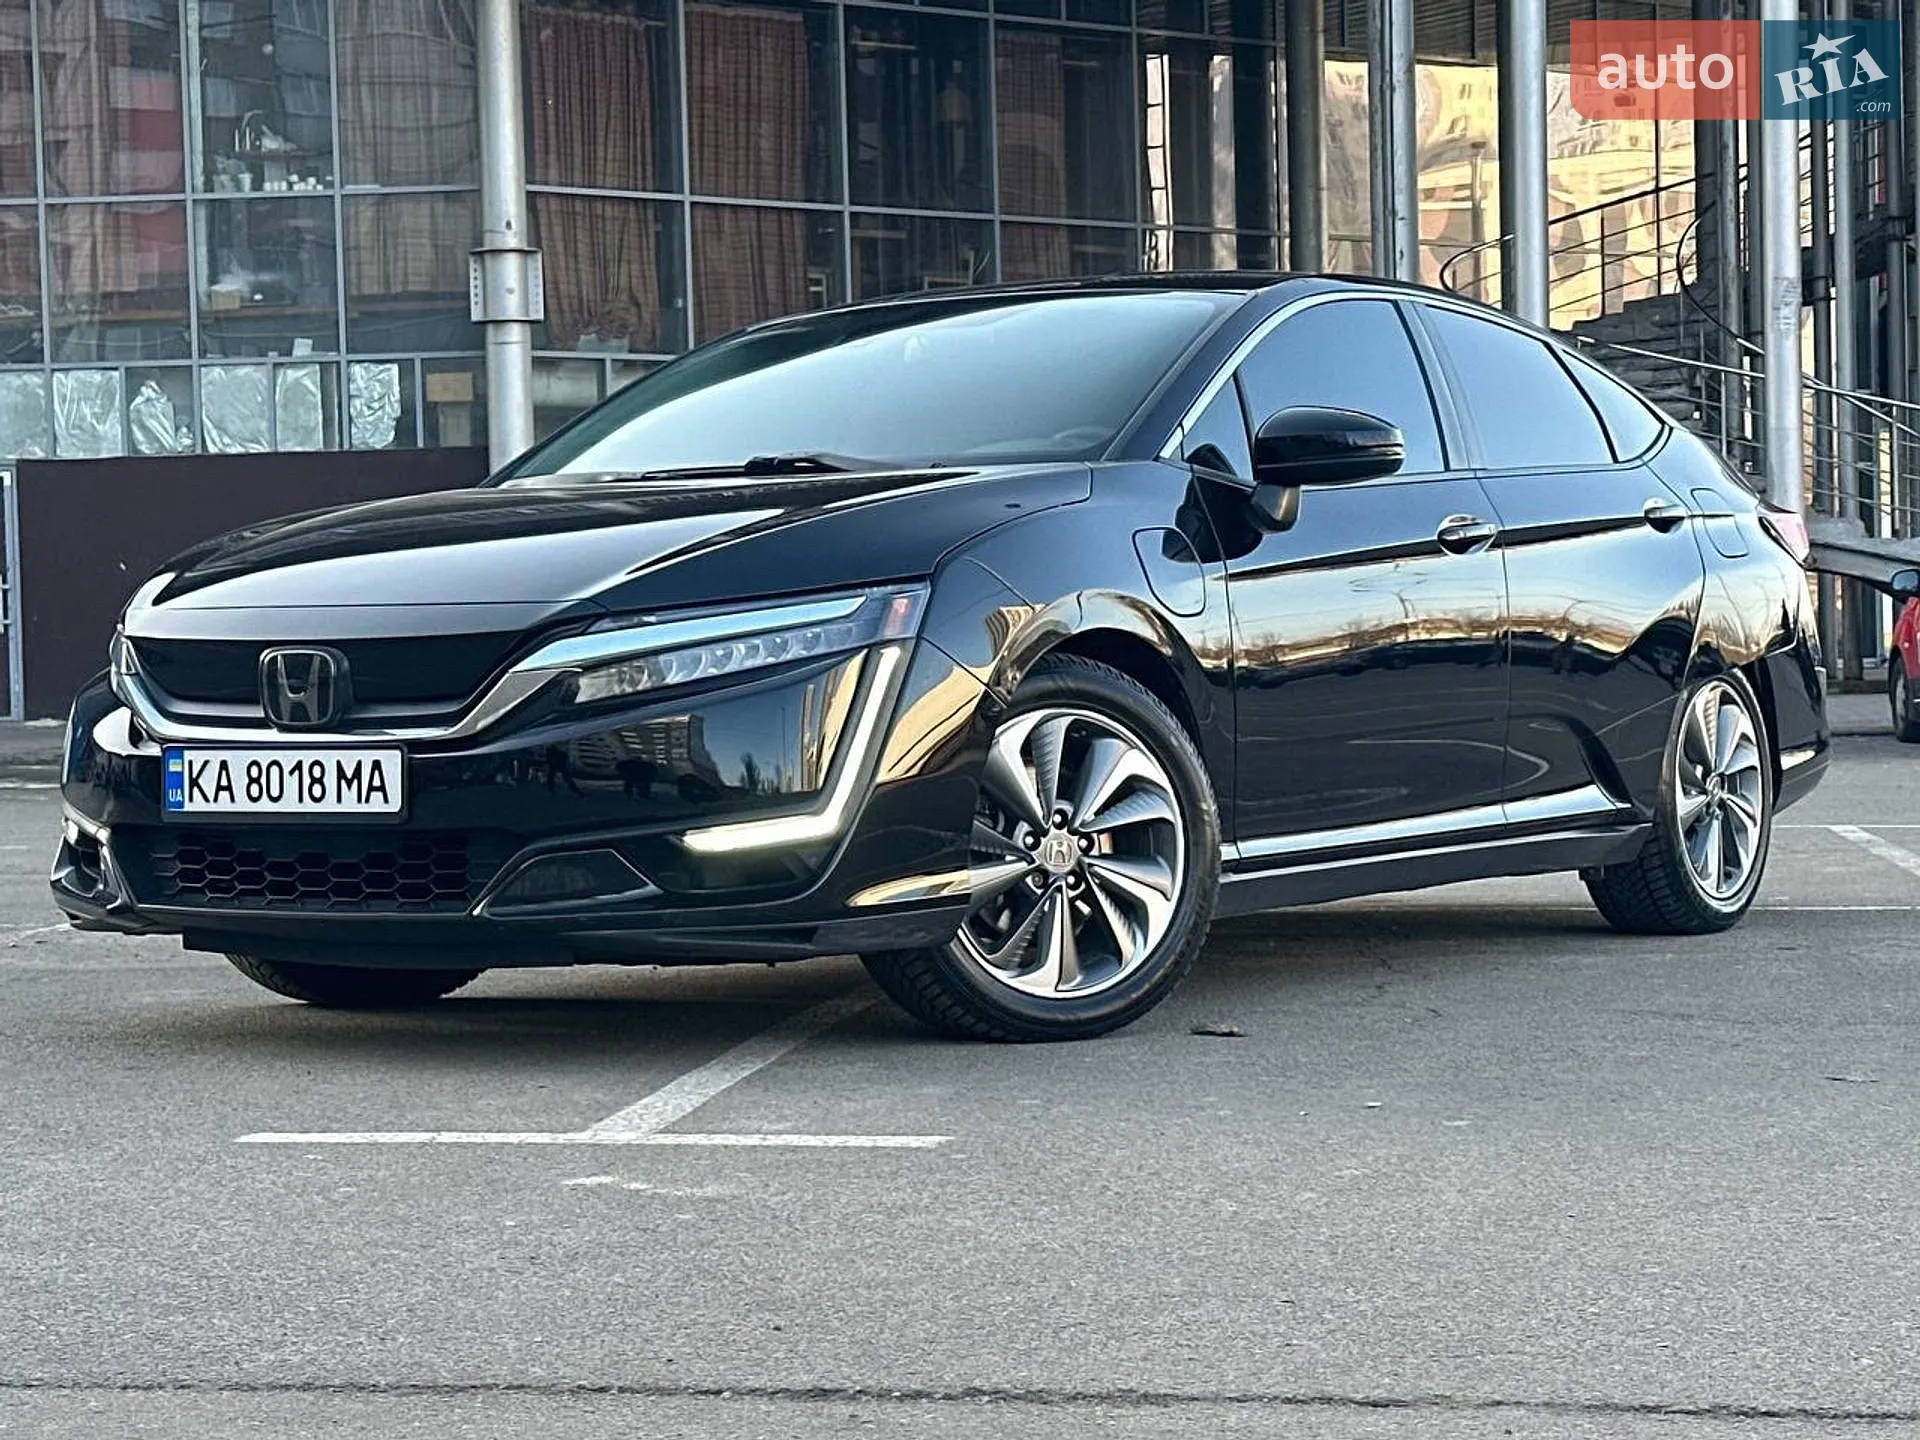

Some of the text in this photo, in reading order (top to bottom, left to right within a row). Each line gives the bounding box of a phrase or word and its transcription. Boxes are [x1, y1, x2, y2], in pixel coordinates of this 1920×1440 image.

[169, 789, 183, 802] UA
[188, 759, 390, 804] KA 8018 MA
